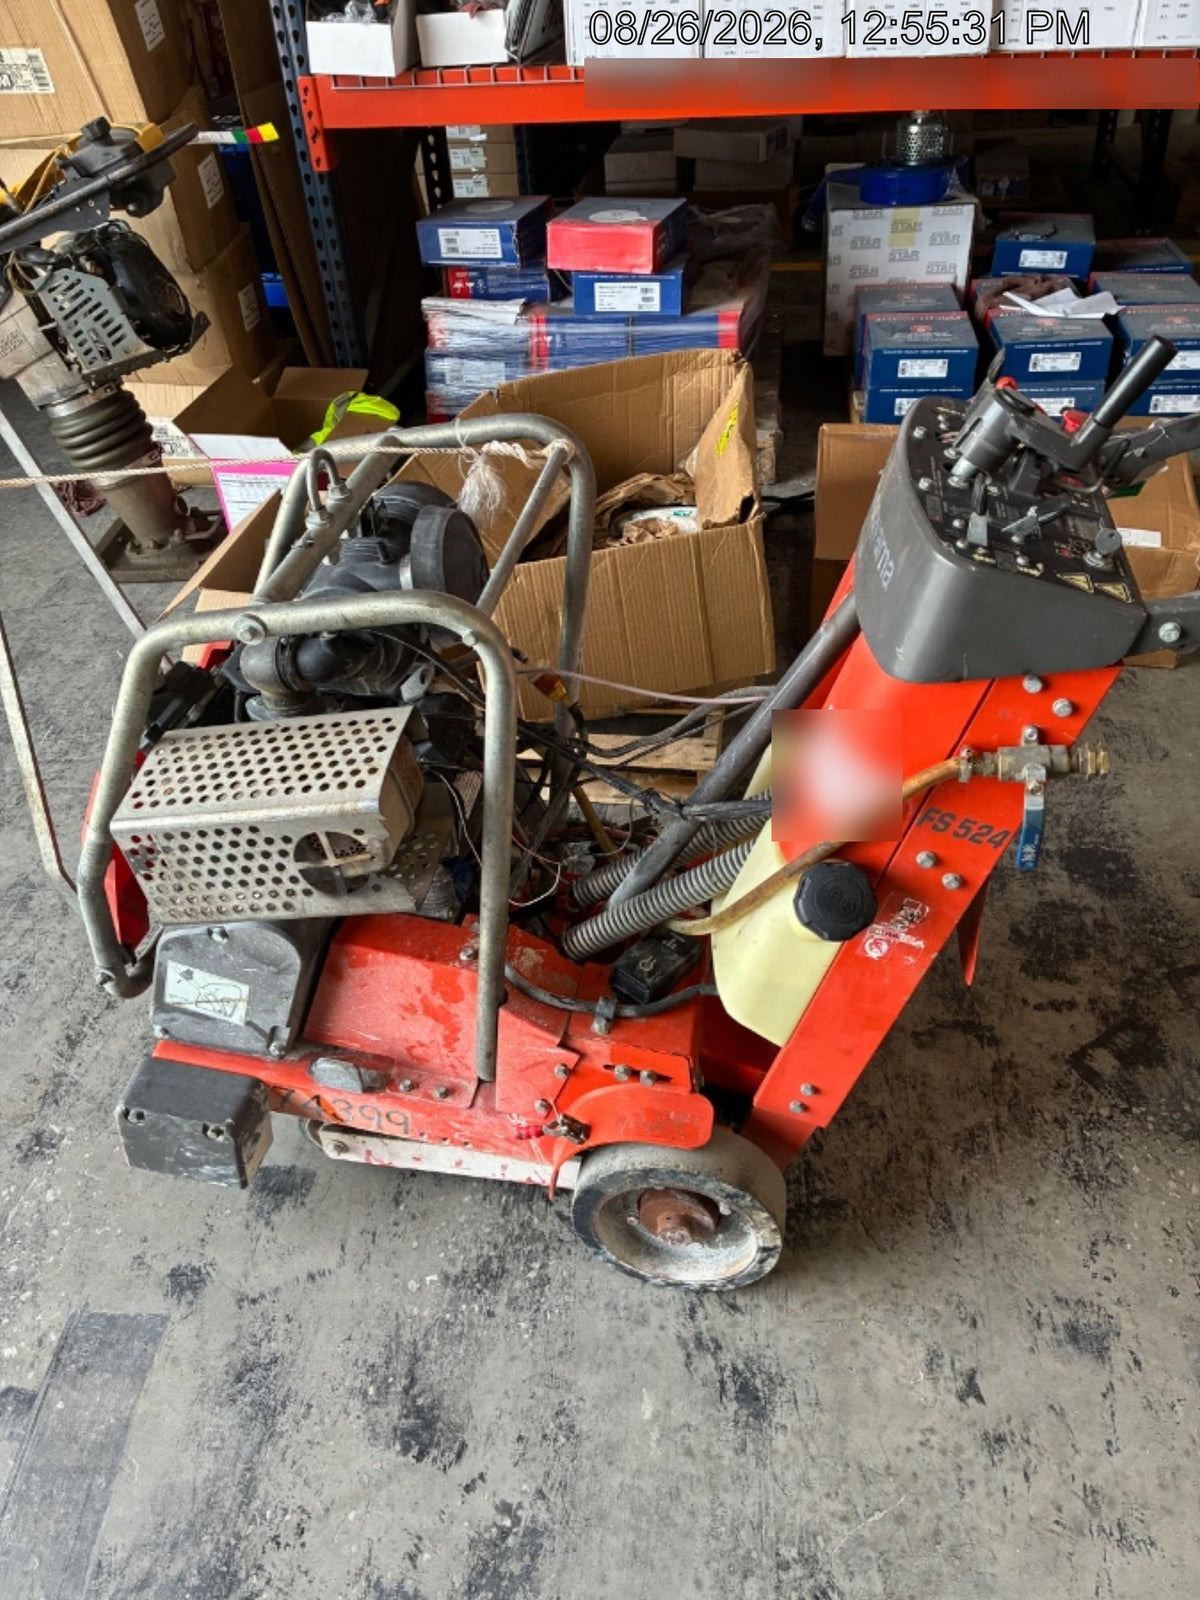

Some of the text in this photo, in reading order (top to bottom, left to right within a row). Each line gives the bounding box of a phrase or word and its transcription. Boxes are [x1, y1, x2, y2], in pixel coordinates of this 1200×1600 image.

[850, 237, 881, 248] STAR
[928, 232, 961, 245] STAR
[888, 250, 919, 262] STAR
[848, 266, 879, 278] STAR
[926, 263, 957, 274] STAR
[917, 807, 1010, 849] FS 524
